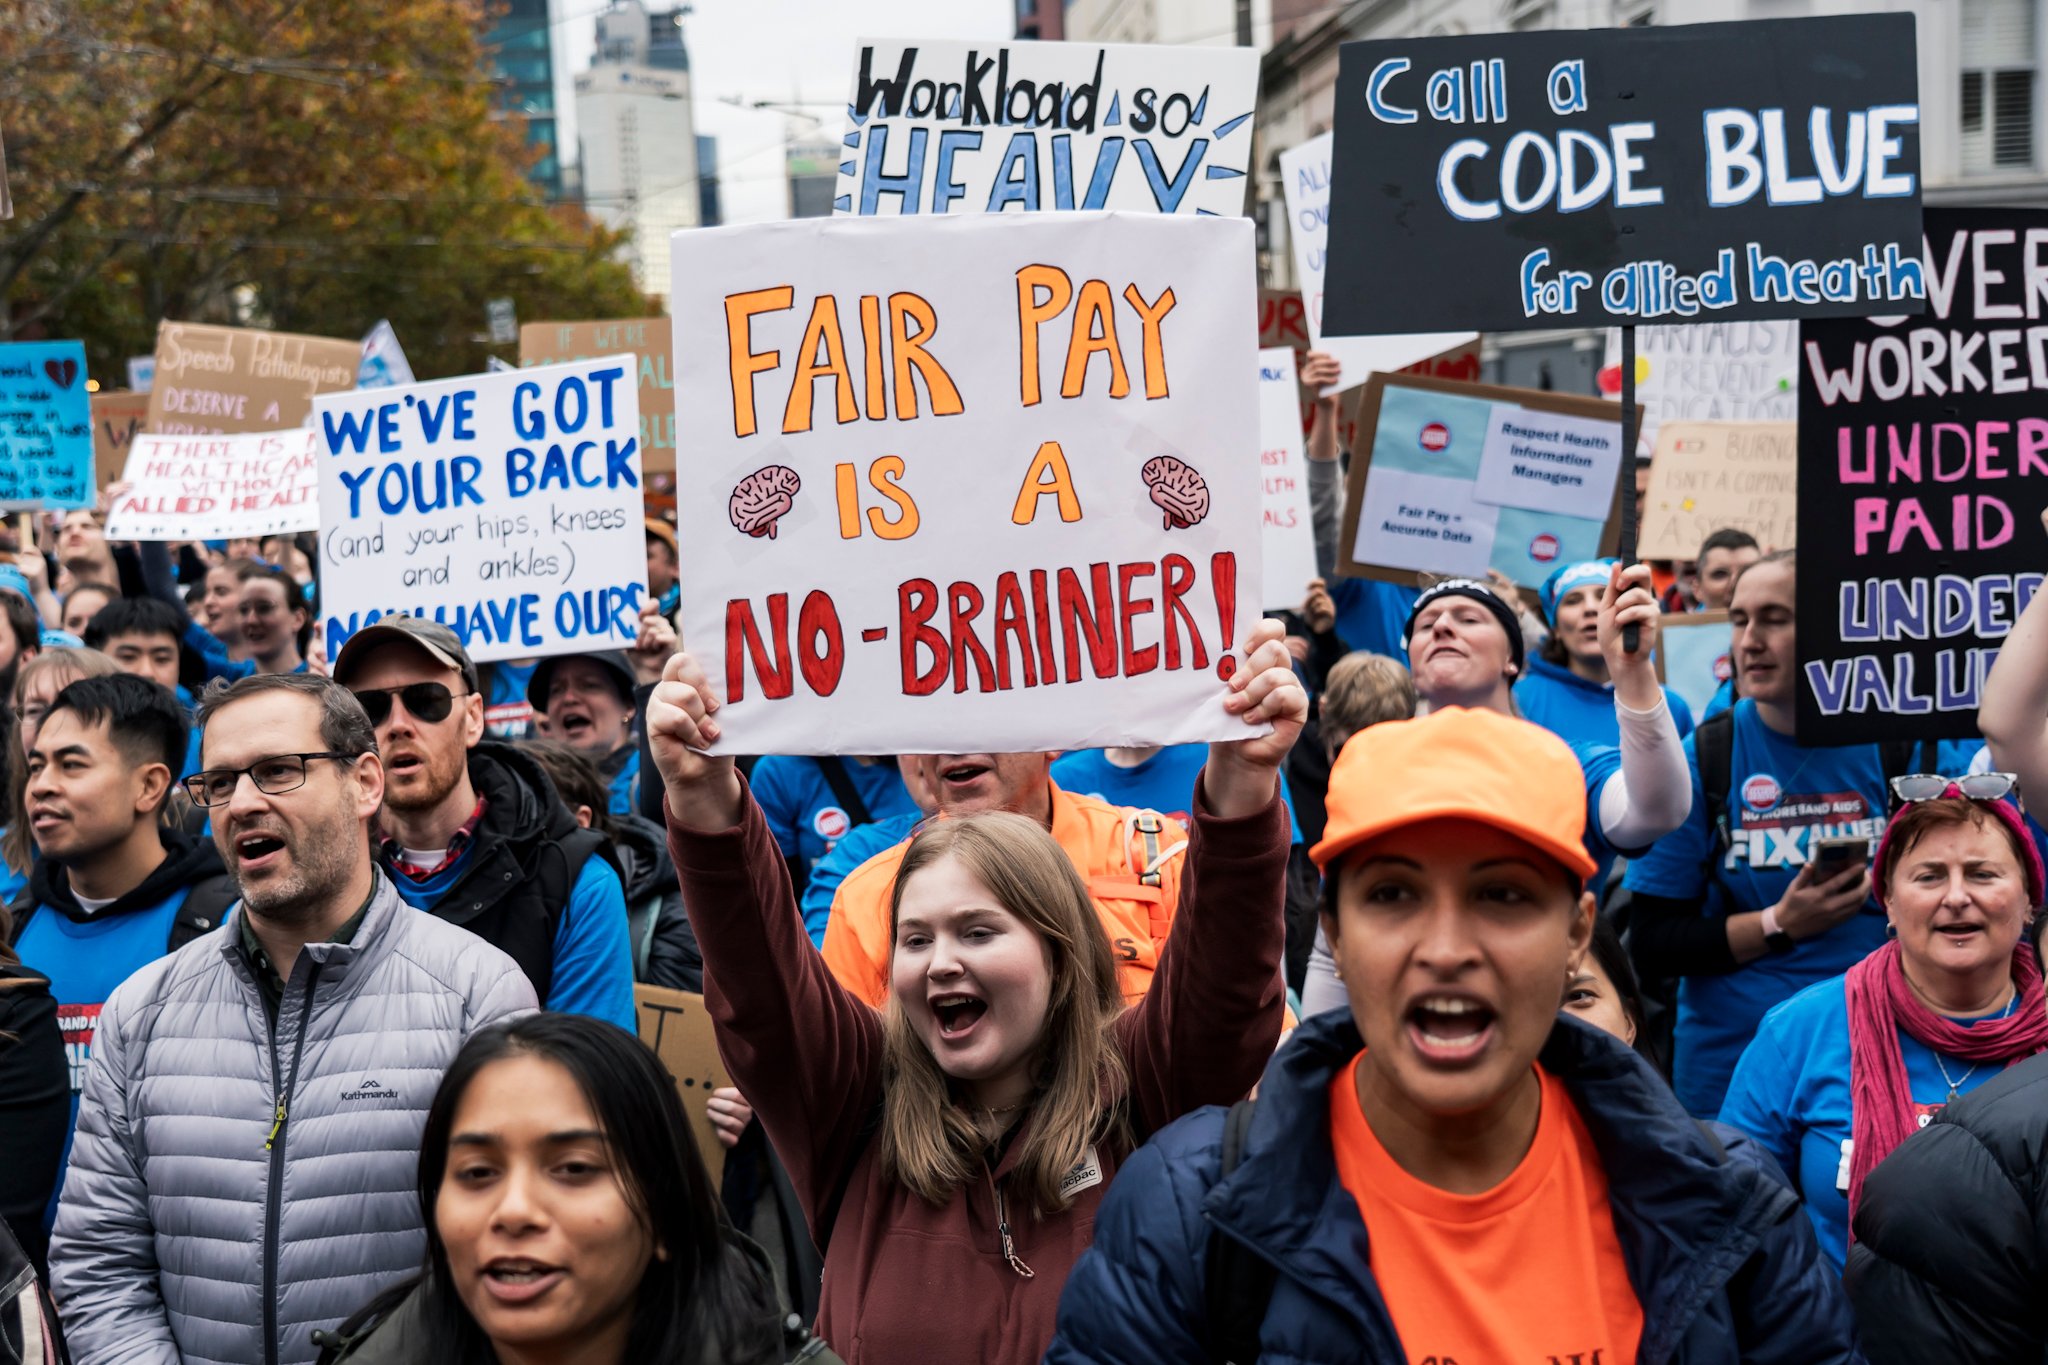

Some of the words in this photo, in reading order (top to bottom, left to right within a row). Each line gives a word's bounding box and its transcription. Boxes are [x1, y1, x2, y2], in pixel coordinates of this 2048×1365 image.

[857, 46, 1105, 134] Workload
[1129, 88, 1192, 138] so
[1365, 57, 1508, 124] Call
[1547, 58, 1588, 115] a
[860, 124, 1209, 215] HEAVY
[1437, 121, 1664, 222] CODE
[1702, 104, 1920, 208] BLUE
[1520, 247, 1593, 318] for
[1600, 247, 1738, 317] allied
[1745, 242, 1926, 304] heath
[1866, 226, 2048, 326] VER
[159, 327, 235, 379] Speech
[249, 332, 351, 400] Pathologists
[724, 285, 965, 438] FAIR
[1015, 263, 1177, 408] PAY
[163, 386, 249, 420] DESERVE
[264, 401, 281, 423] A
[322, 390, 476, 456] WE'VE
[512, 367, 623, 441] GOT
[1501, 421, 1560, 443] Respect
[1563, 425, 1611, 450] Health
[144, 440, 233, 458] THERE
[259, 436, 284, 454] IS
[339, 456, 486, 518] YOUR
[506, 437, 639, 498] BACK
[1510, 444, 1593, 468] Information
[1511, 464, 1584, 488] Managers
[1838, 417, 2048, 485] UNDER
[120, 496, 216, 514] ALLIED
[229, 485, 319, 512] HEALT
[180, 474, 297, 497] WITHOUT
[835, 455, 920, 541] IS
[1012, 441, 1083, 525] A
[1398, 504, 1424, 519] Fair
[1427, 507, 1450, 524] Pay
[326, 521, 385, 566] (and
[405, 523, 463, 555] your
[477, 513, 539, 548] hips,
[551, 503, 627, 534] knees
[1381, 521, 1439, 540] Accurate
[1442, 528, 1472, 544] Data
[1854, 494, 2016, 556] PAID
[402, 555, 450, 587] and
[479, 541, 576, 586] ankles)
[436, 593, 543, 648] HAVE
[725, 551, 1237, 705] NO-BRAINER!
[1804, 647, 2000, 717] VALU
[1832, 800, 1862, 814] AIDS
[1725, 825, 1809, 870] FIX
[341, 1089, 399, 1101] Kathmandu
[1060, 1168, 1097, 1192] acpac
